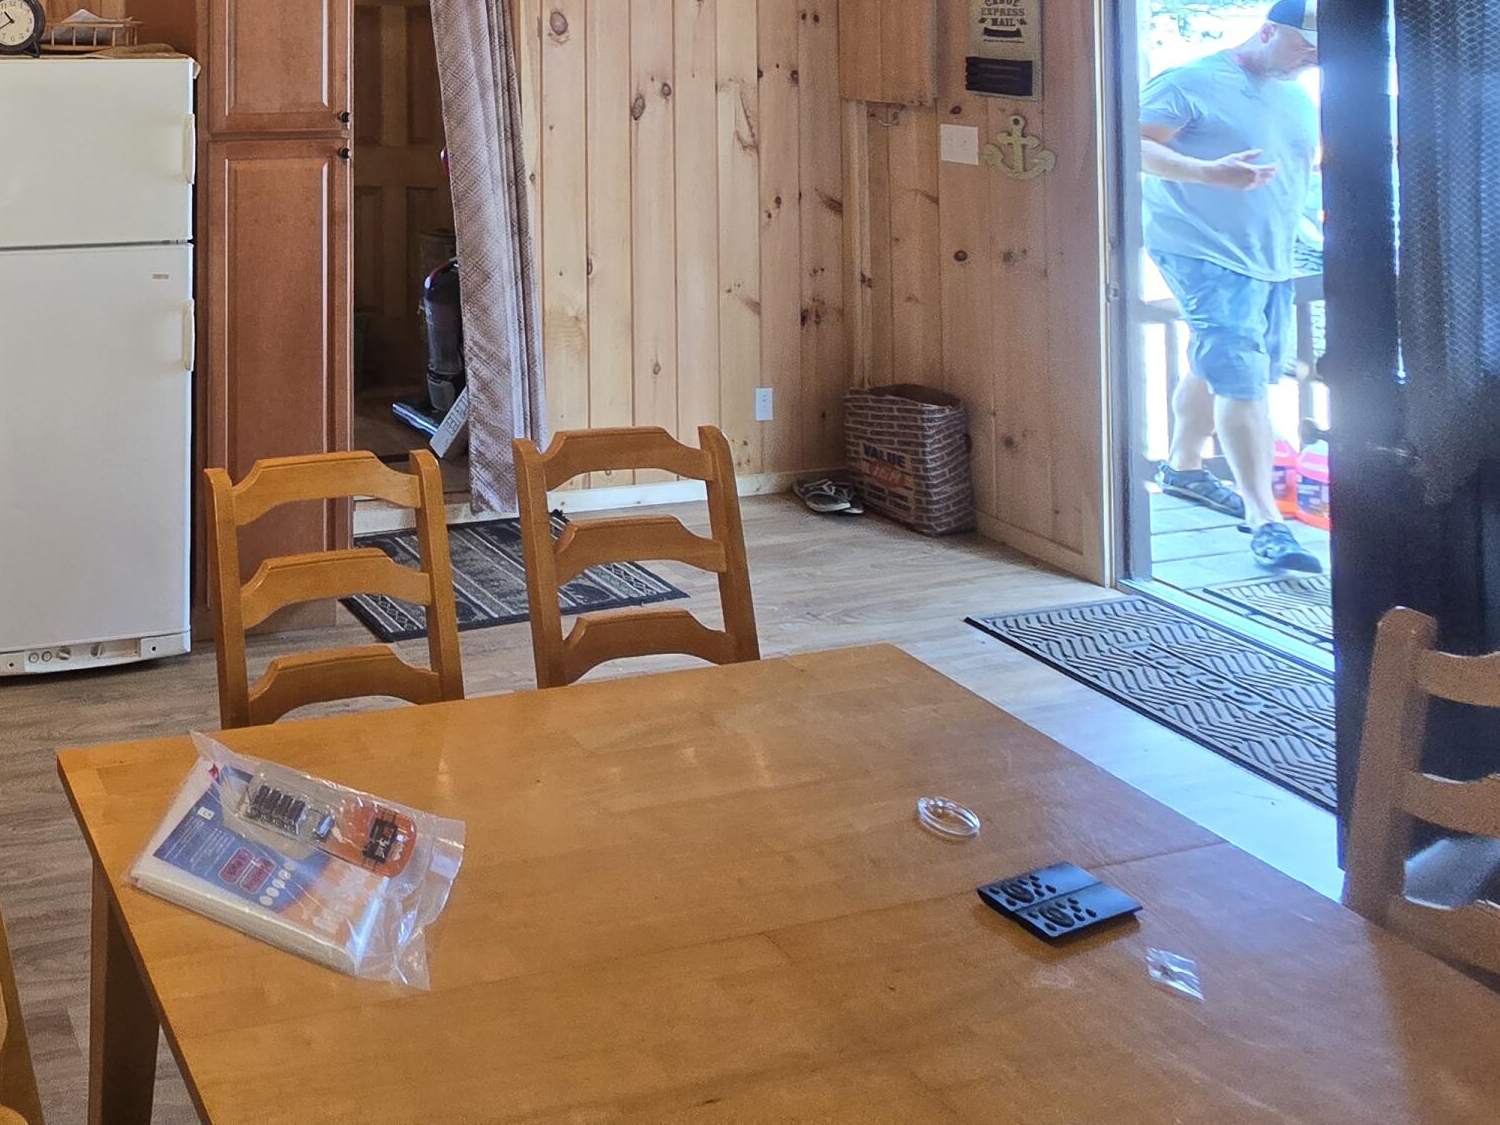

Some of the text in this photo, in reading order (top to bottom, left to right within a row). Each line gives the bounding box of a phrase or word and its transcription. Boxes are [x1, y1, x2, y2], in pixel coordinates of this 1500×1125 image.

[981, 7, 1025, 17] EXPRESS
[991, 17, 1016, 27] MAIL
[863, 443, 906, 468] VALUE
